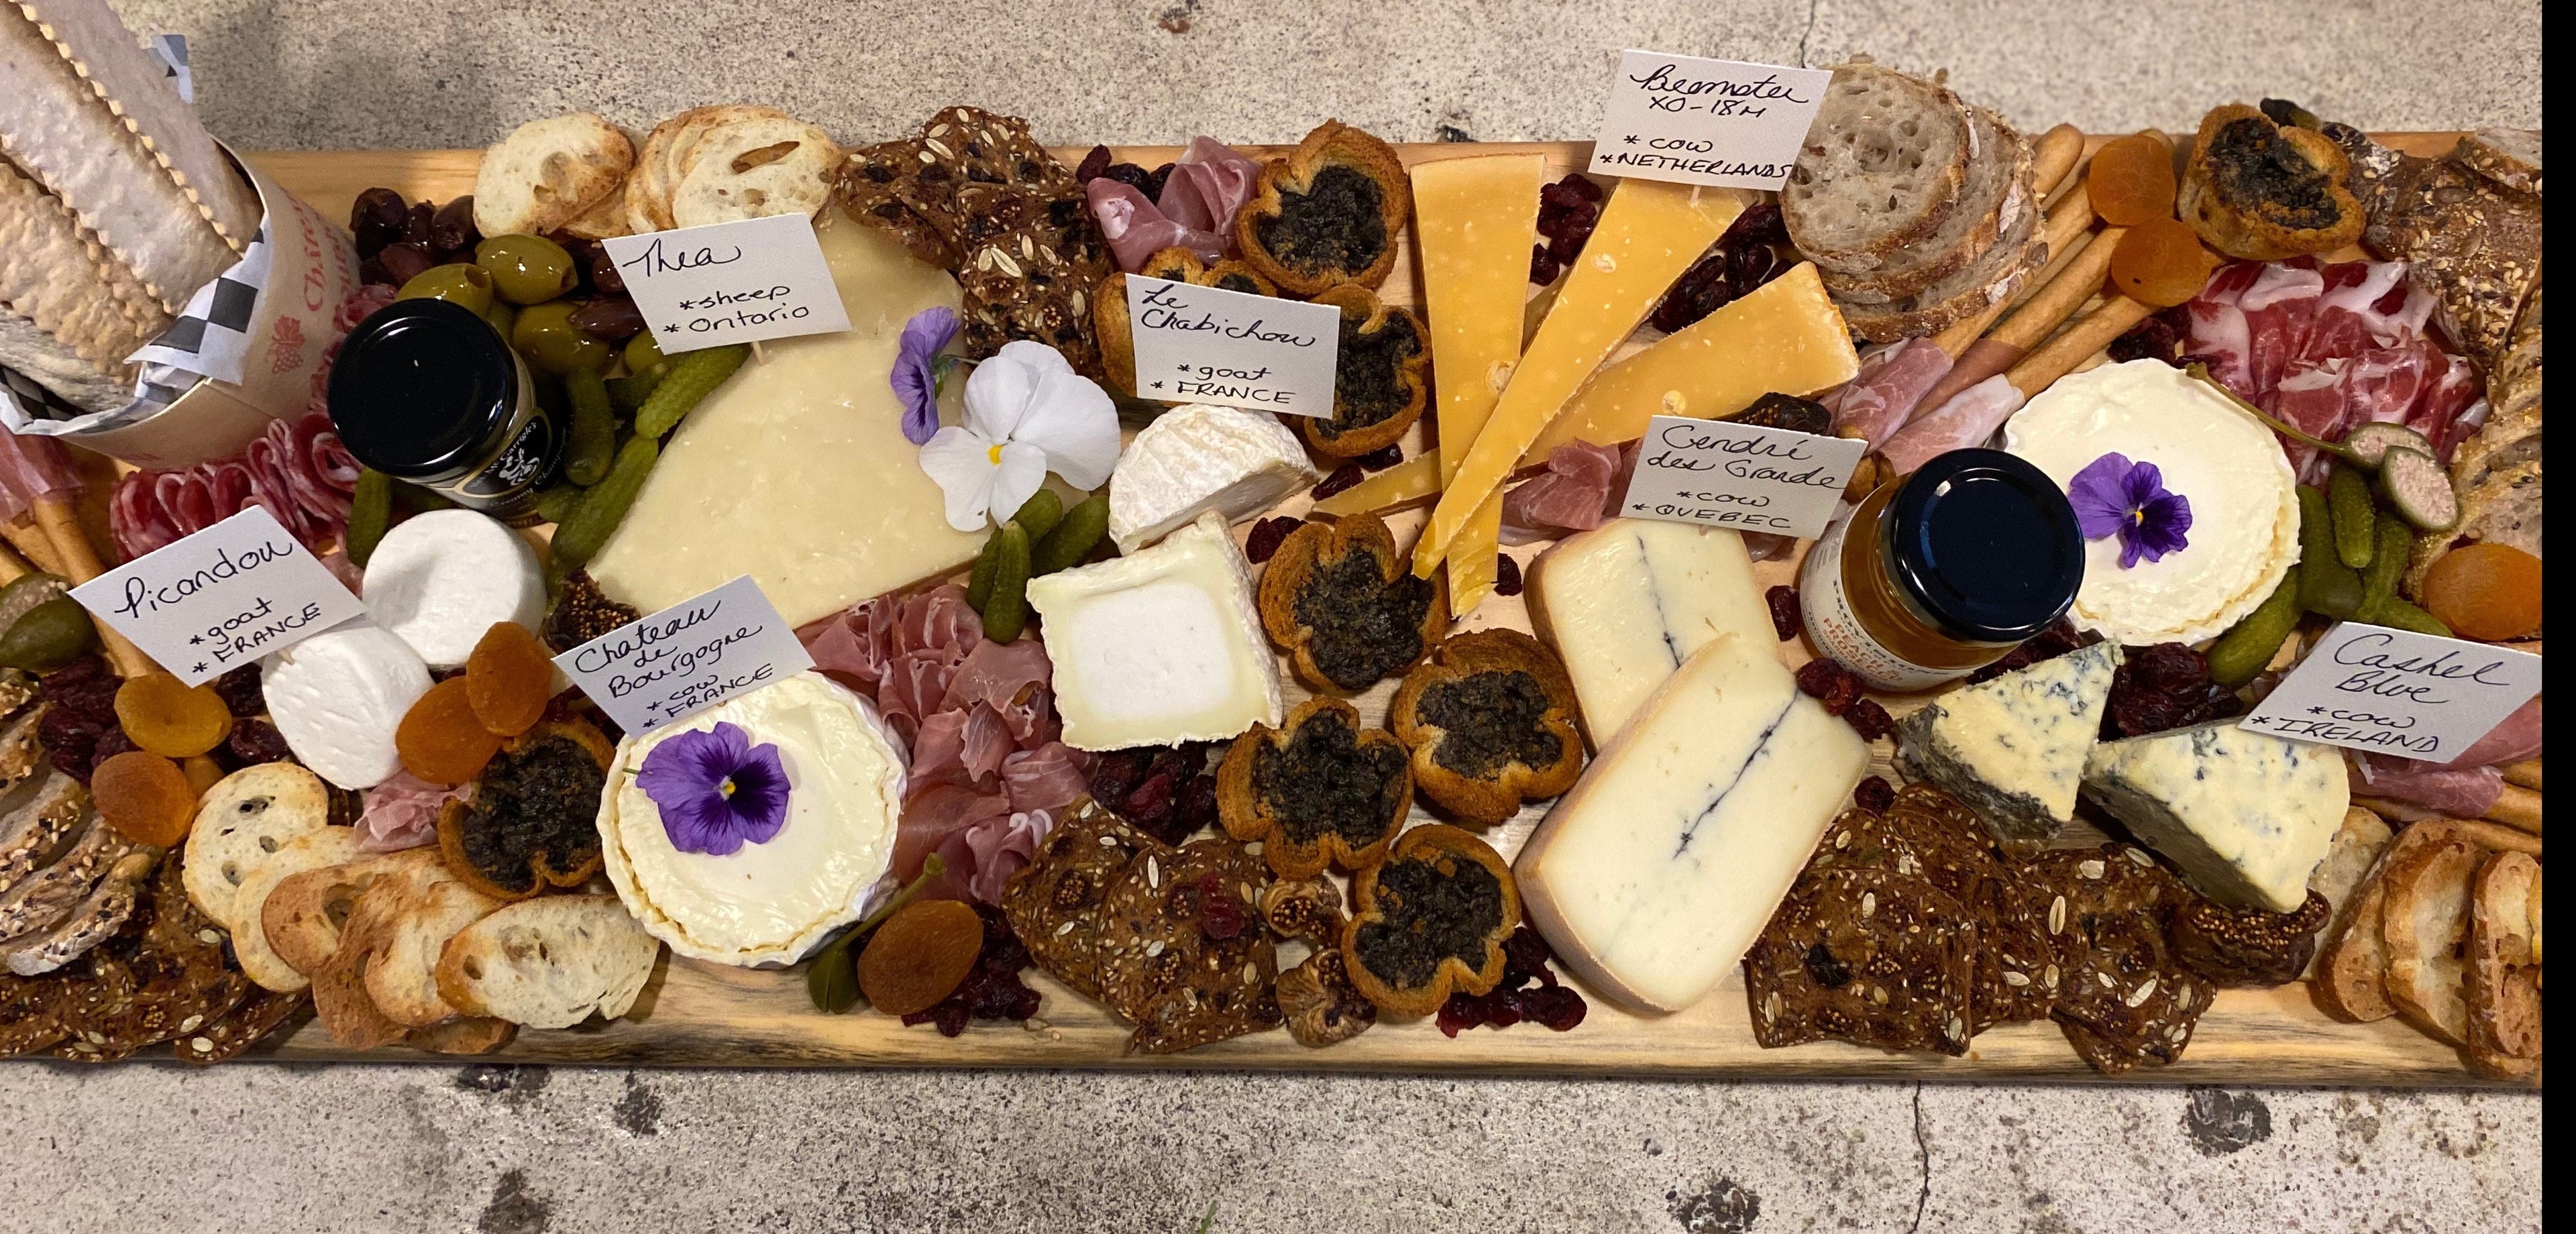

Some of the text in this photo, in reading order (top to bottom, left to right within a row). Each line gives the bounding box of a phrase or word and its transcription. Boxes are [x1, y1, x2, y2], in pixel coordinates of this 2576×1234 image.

[1617, 152, 1793, 178] NETHERLANDS
[622, 237, 741, 277] Thea
[698, 285, 790, 309] sheep
[1141, 283, 1188, 309] Le
[1140, 308, 1316, 347] Chabichou
[1177, 380, 1296, 404] FRANCE
[1195, 366, 1272, 381] goat
[1655, 504, 1791, 528] QUEBEC
[114, 541, 294, 618] Picandou
[207, 597, 273, 646] goat
[212, 602, 322, 664] FRANCE
[574, 600, 722, 673] Chateau
[608, 625, 763, 699] Bourgogne
[633, 645, 678, 669] de
[1823, 616, 1903, 681] PROSECCO
[1835, 624, 1884, 669] PEACH
[2334, 633, 2510, 686] Cashel
[664, 663, 774, 718] FRANCE
[2273, 718, 2439, 753] IRELAND
